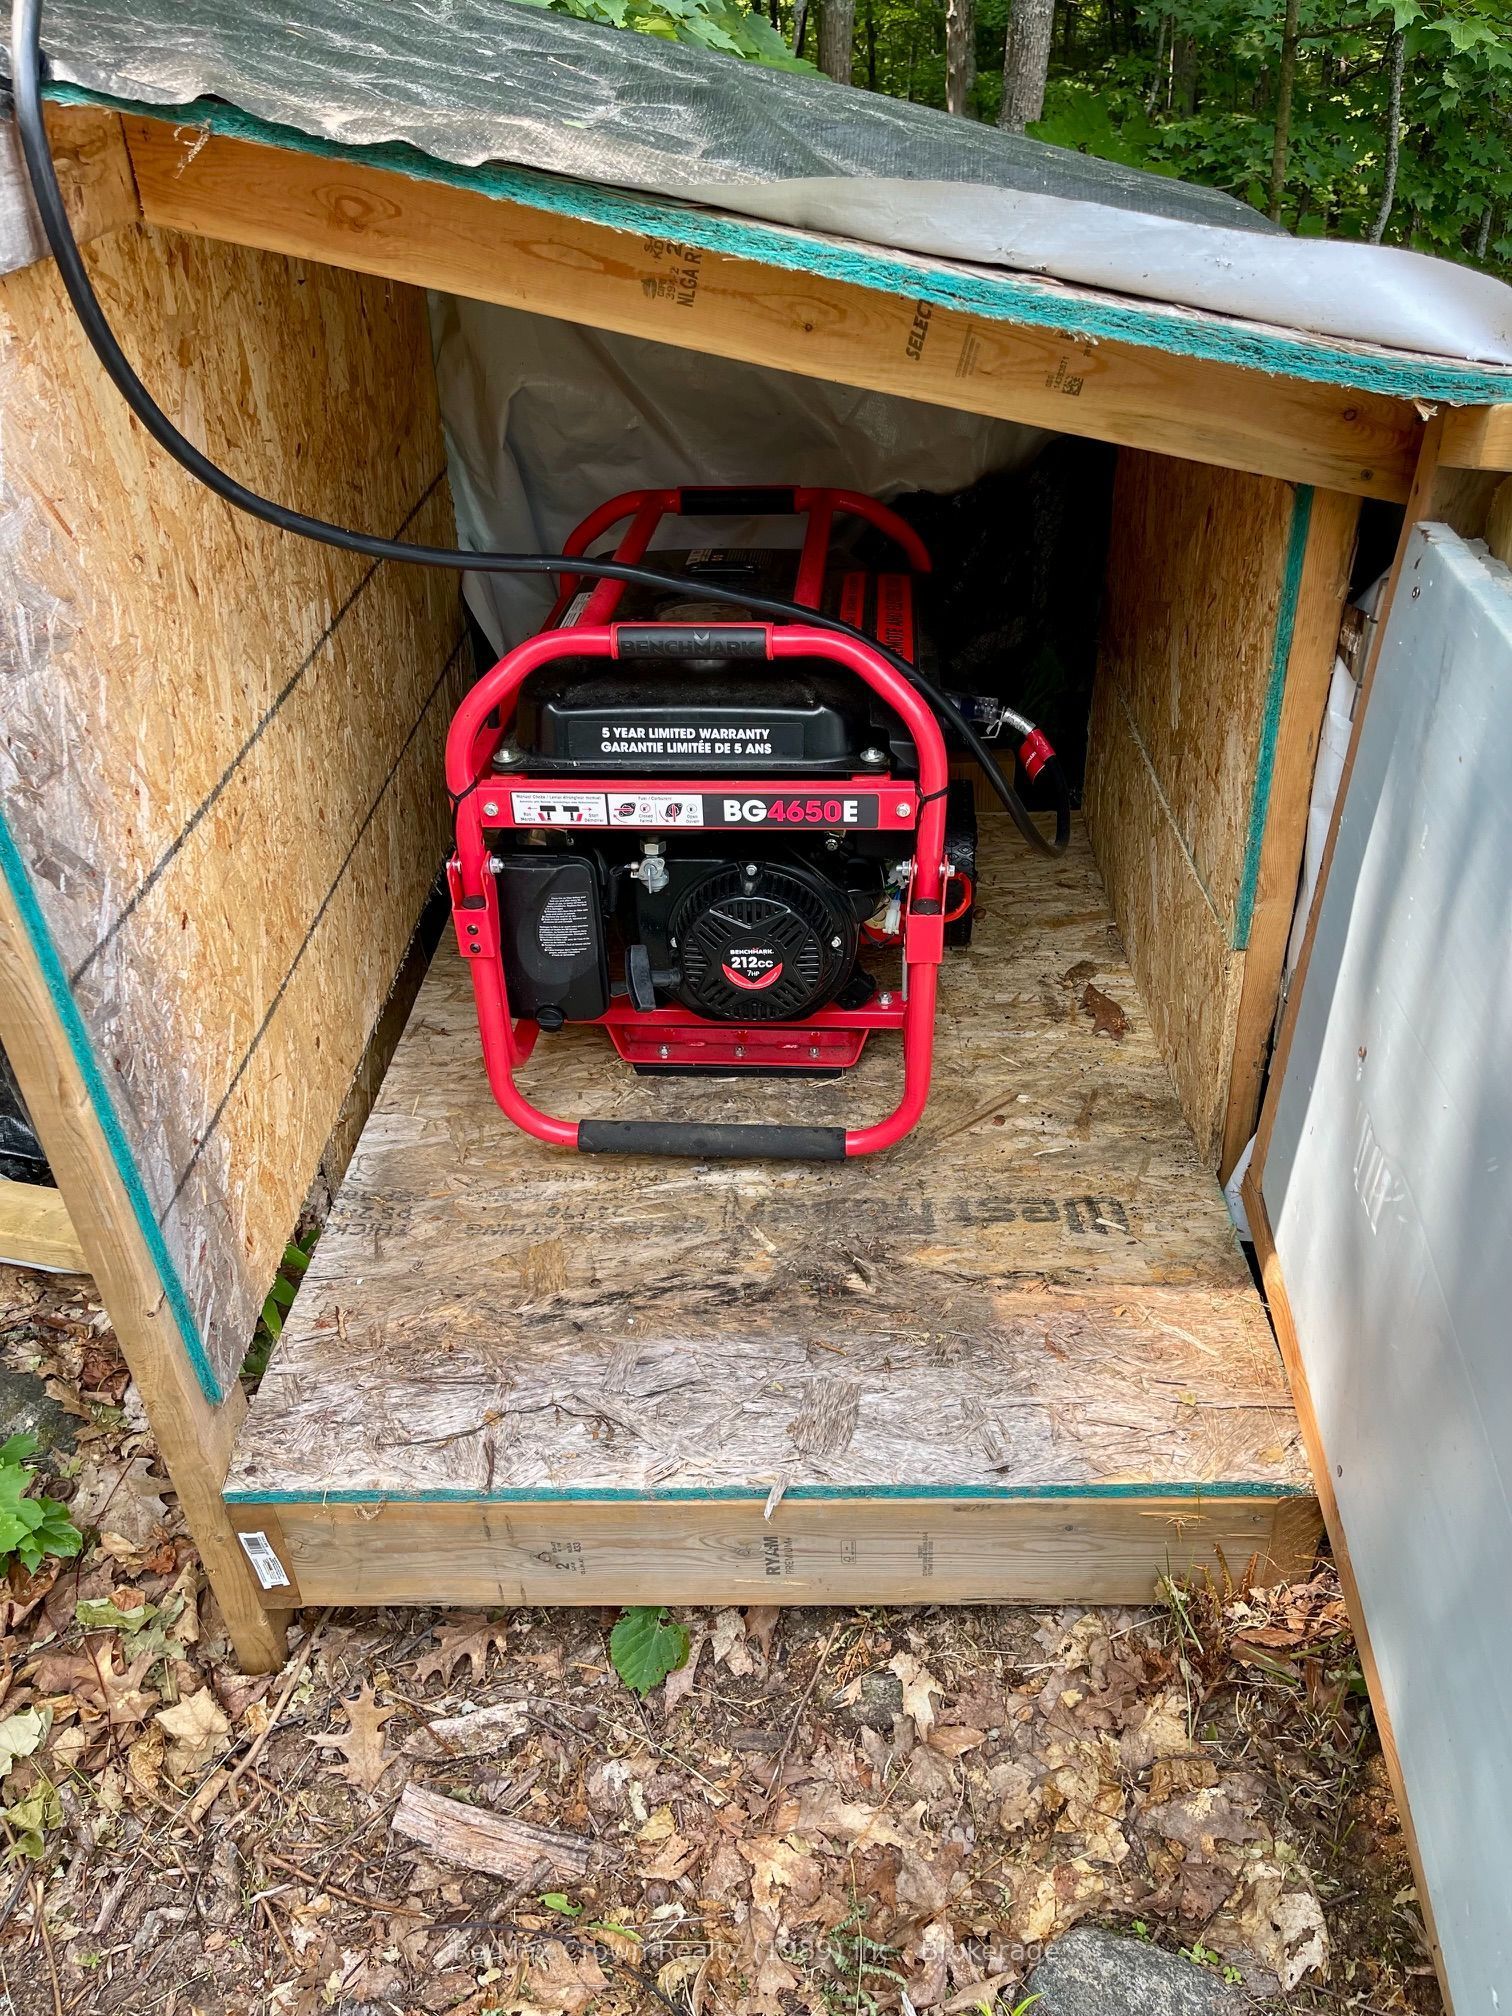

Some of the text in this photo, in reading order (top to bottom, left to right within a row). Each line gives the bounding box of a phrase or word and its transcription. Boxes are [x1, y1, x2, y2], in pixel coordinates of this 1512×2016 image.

[677, 270, 700, 308] NLGA
[621, 640, 758, 656] BENCHMARK
[602, 728, 770, 740] 5 YEAR LIMITED WARRANTY
[601, 740, 772, 754] GARANTIE LIMITÉE DE 5 ANS
[723, 799, 858, 823] BG4650E
[763, 1536, 781, 1576] RYAM
